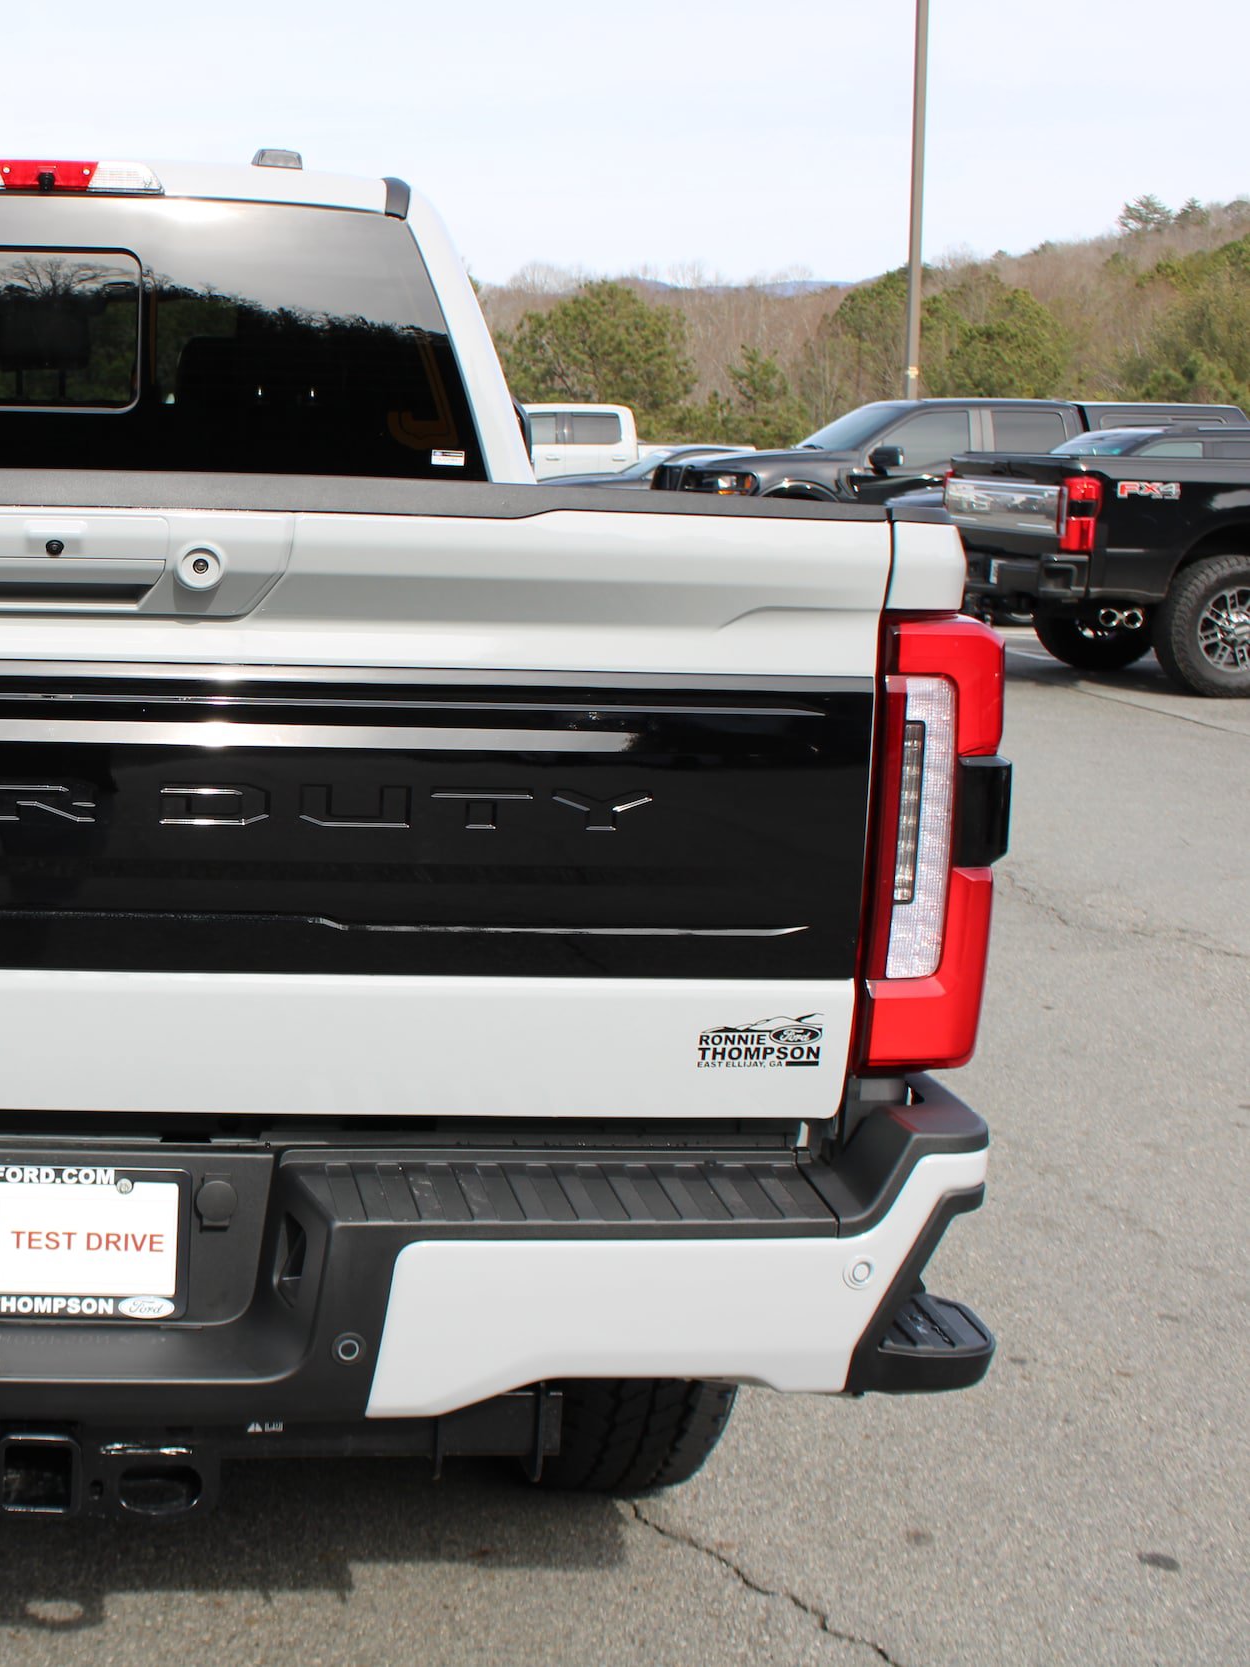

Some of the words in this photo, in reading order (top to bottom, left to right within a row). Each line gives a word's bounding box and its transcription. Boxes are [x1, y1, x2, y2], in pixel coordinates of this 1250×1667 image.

[1117, 481, 1180, 499] FX4
[159, 781, 654, 832] DUTY
[699, 1034, 767, 1046] RONNIE
[697, 1046, 821, 1061] THOMPSON
[725, 1061, 766, 1069] ELLIJAY,
[11, 1231, 76, 1250] TEST
[86, 1232, 164, 1253] DRIVE
